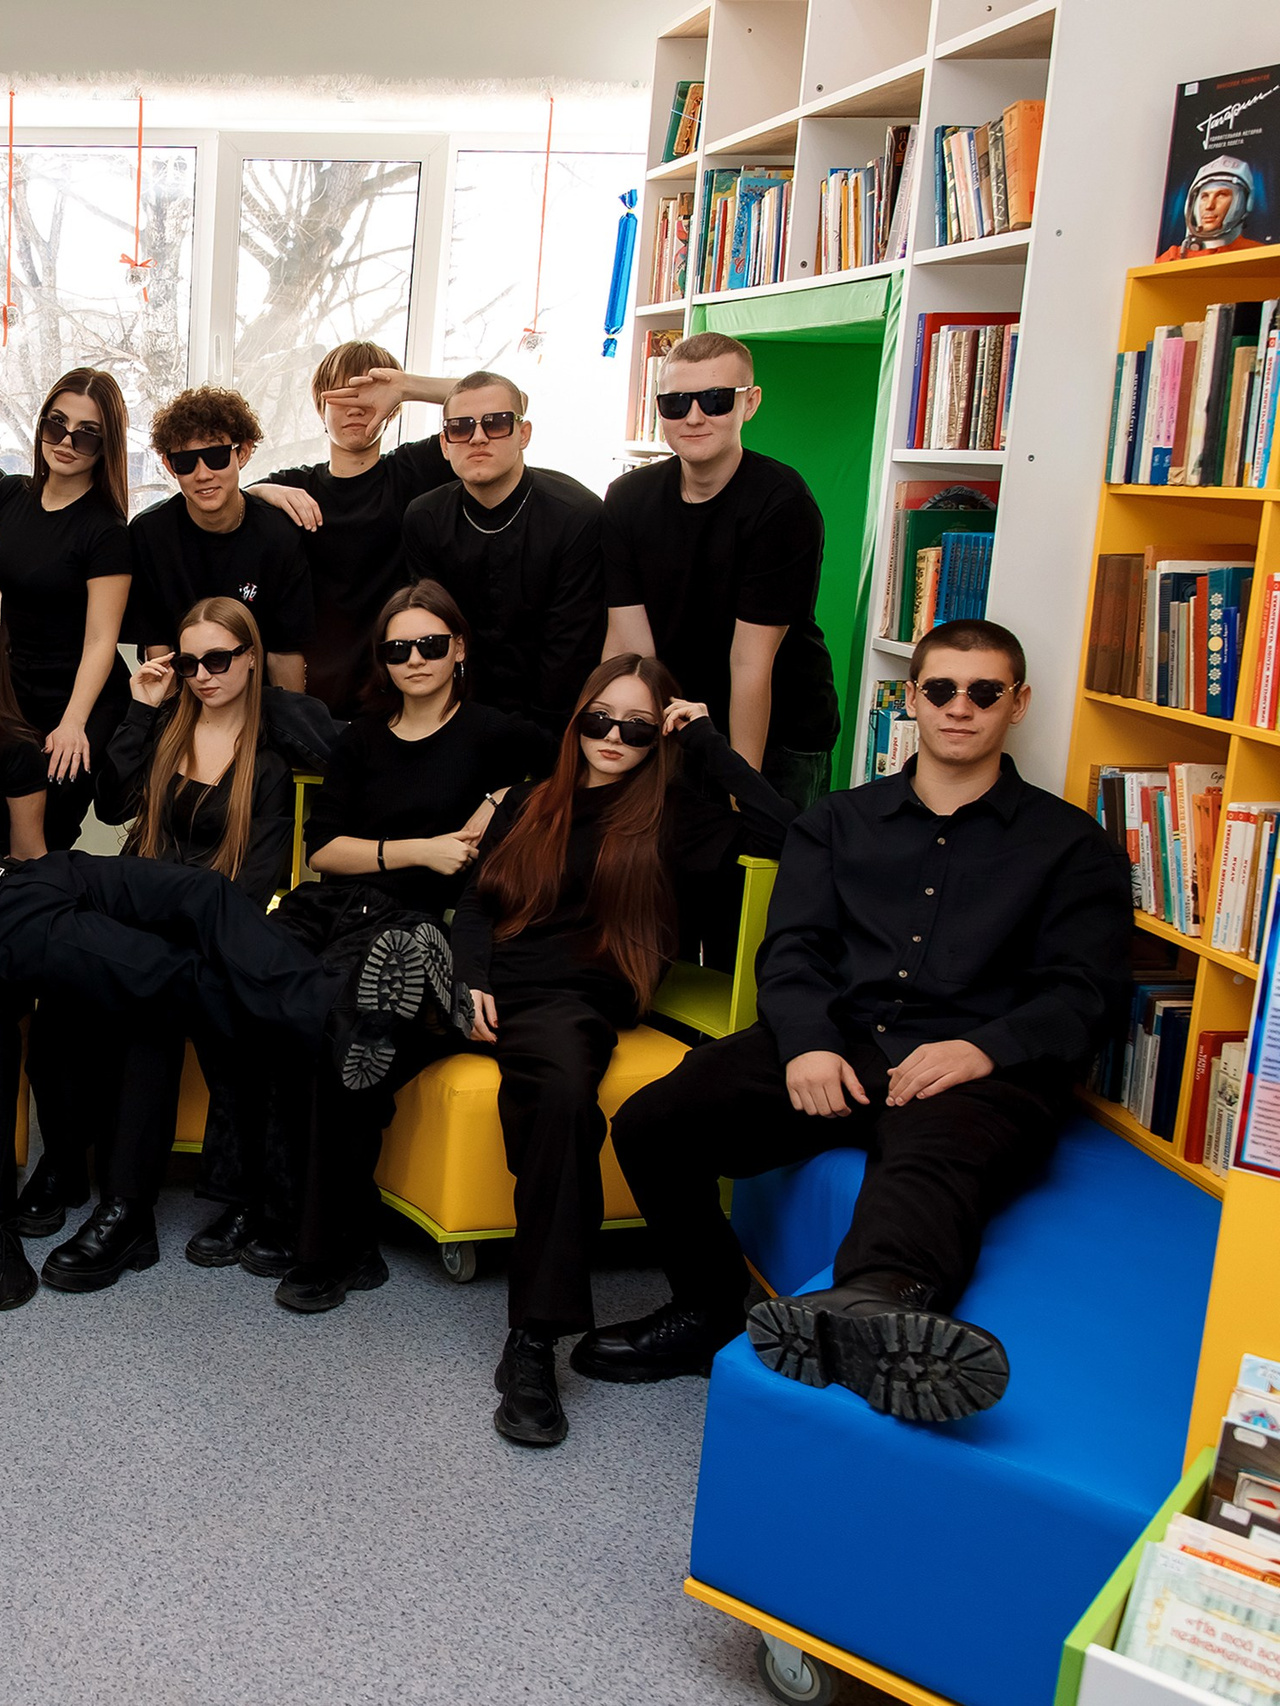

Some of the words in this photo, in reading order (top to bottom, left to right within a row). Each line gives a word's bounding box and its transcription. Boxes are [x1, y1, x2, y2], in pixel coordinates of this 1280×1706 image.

[1177, 778, 1185, 821] БЕРЛИНА
[1180, 823, 1186, 835] ДО
[1183, 878, 1189, 890] ОТ
